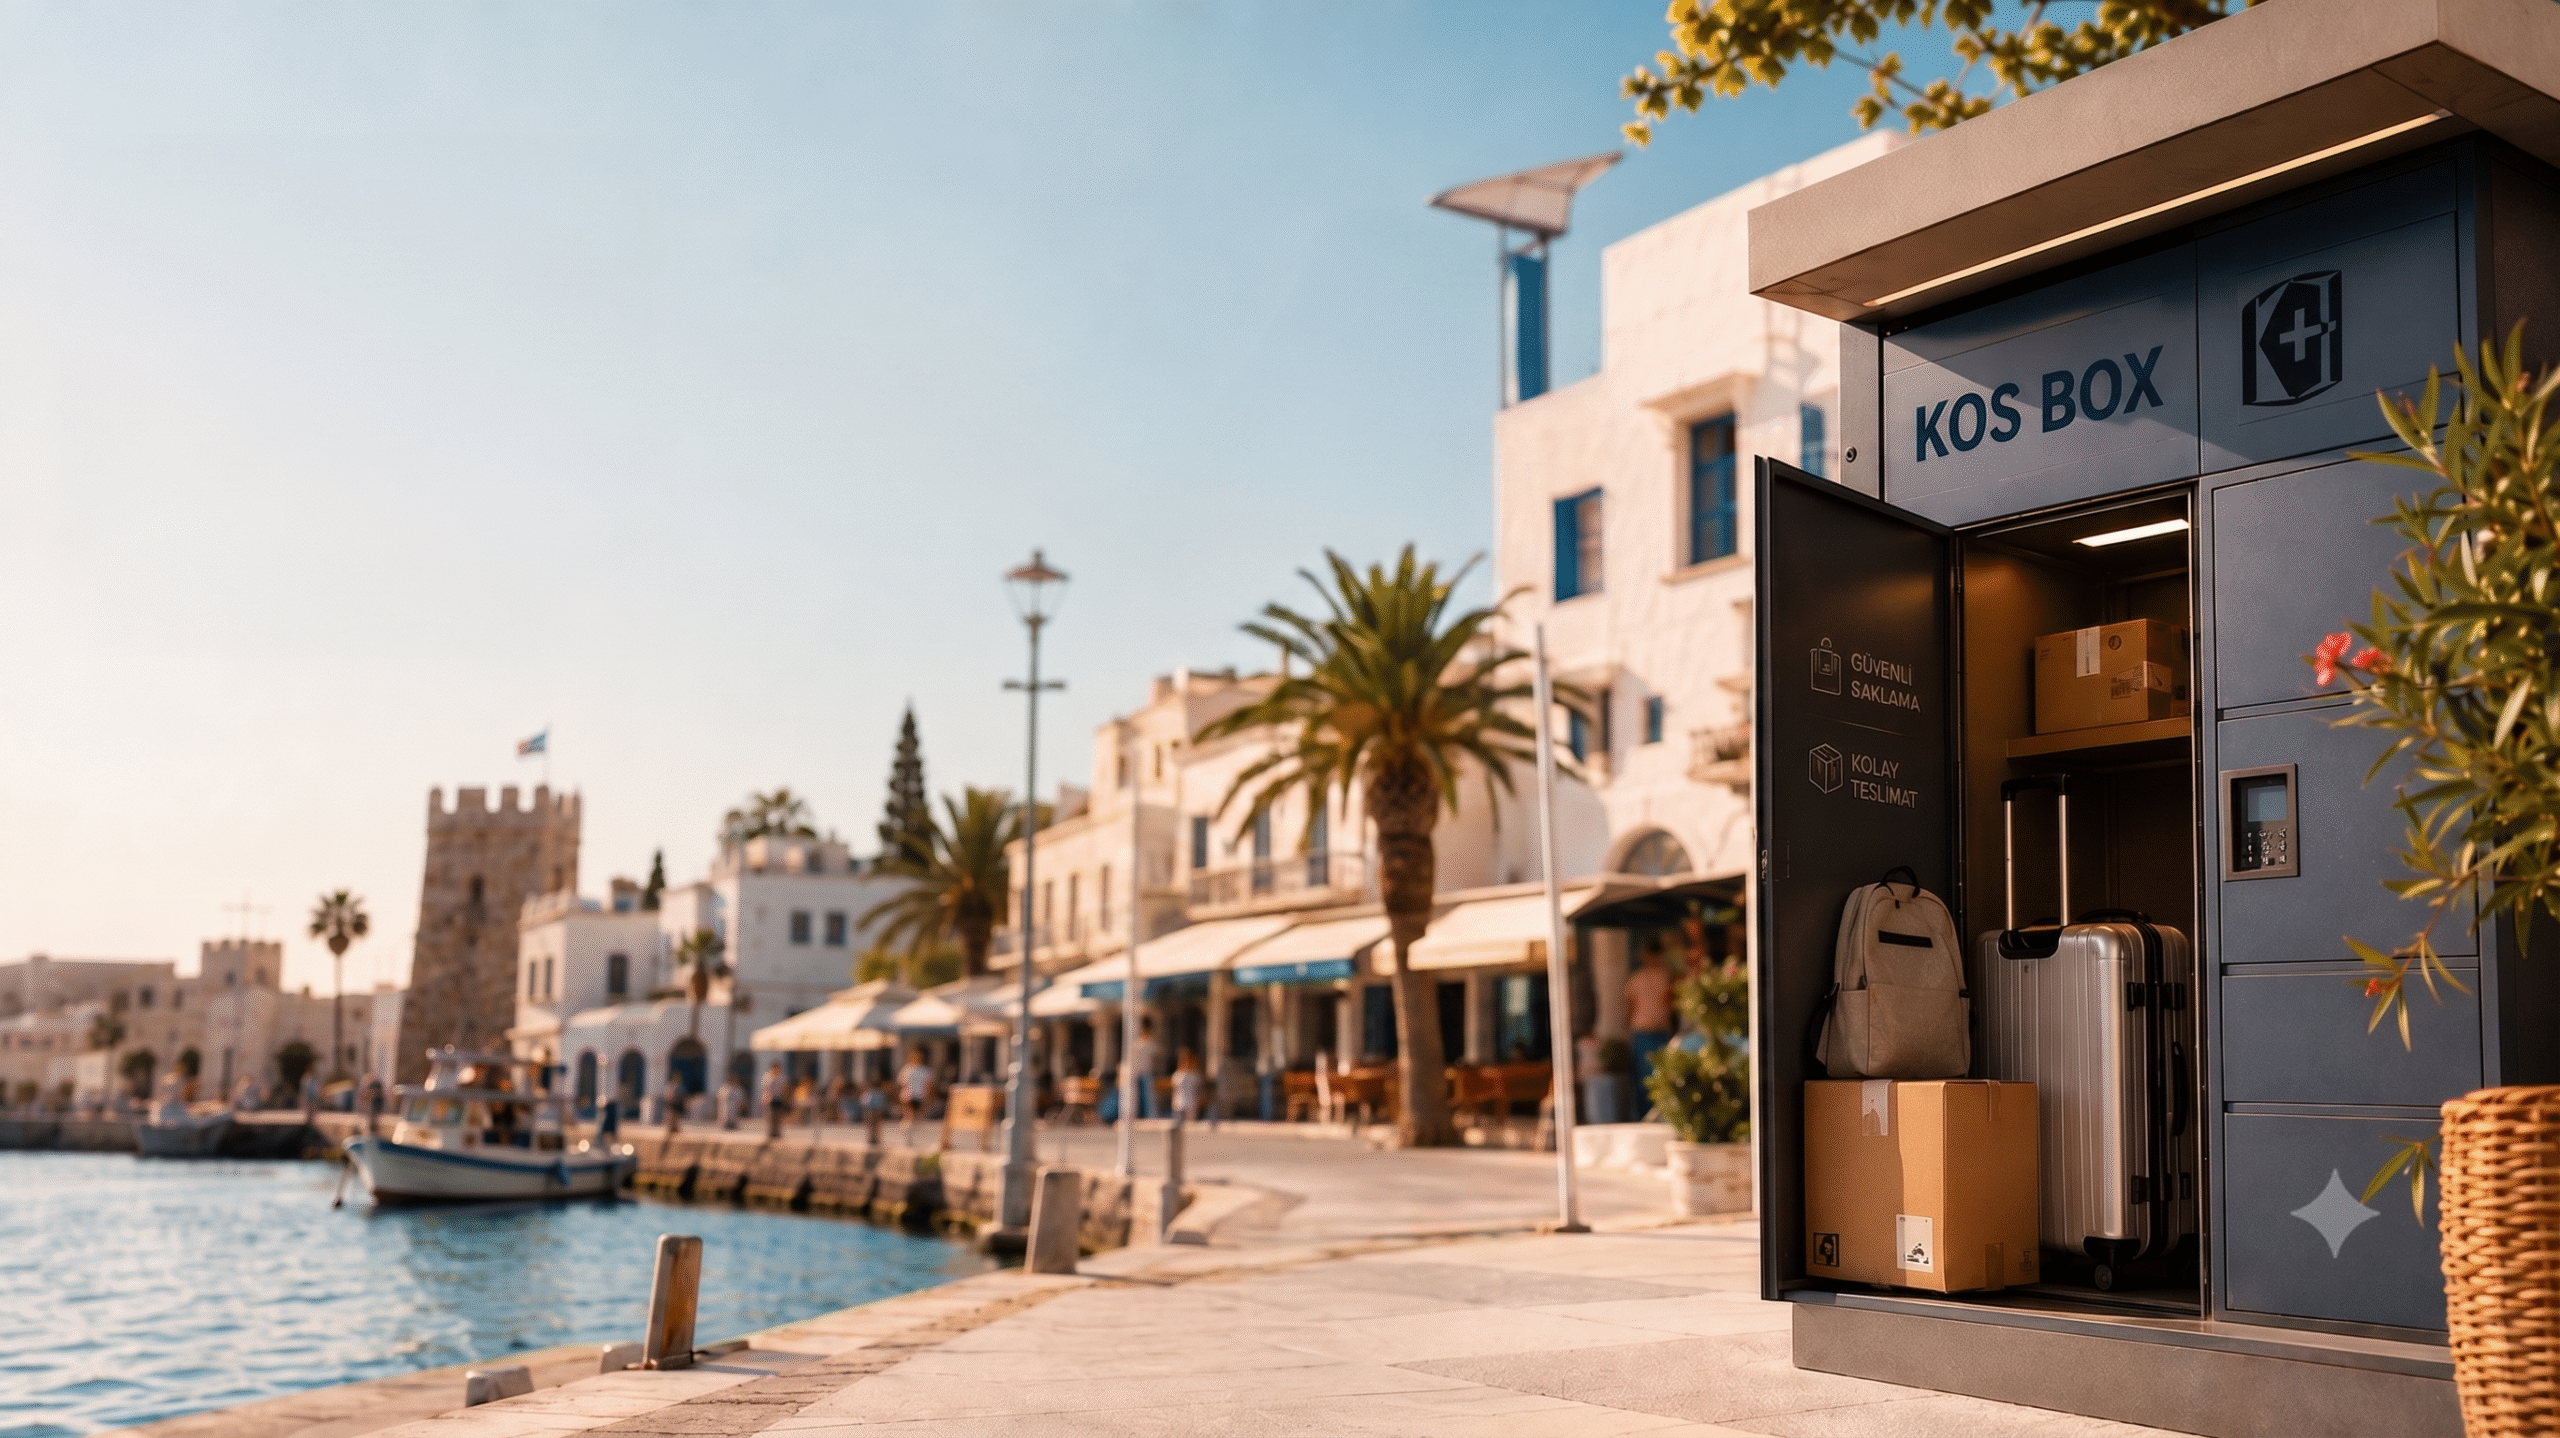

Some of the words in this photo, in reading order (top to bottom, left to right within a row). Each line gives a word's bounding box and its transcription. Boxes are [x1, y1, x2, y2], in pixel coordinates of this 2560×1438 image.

[1916, 382, 2021, 462] KOS
[2042, 345, 2164, 433] BOX
[1851, 652, 1912, 686] GÜVENLİ
[1851, 680, 1921, 713] SAKLAMA
[1851, 753, 1899, 779] KOLAY
[1850, 778, 1919, 809] TESLİMAT
